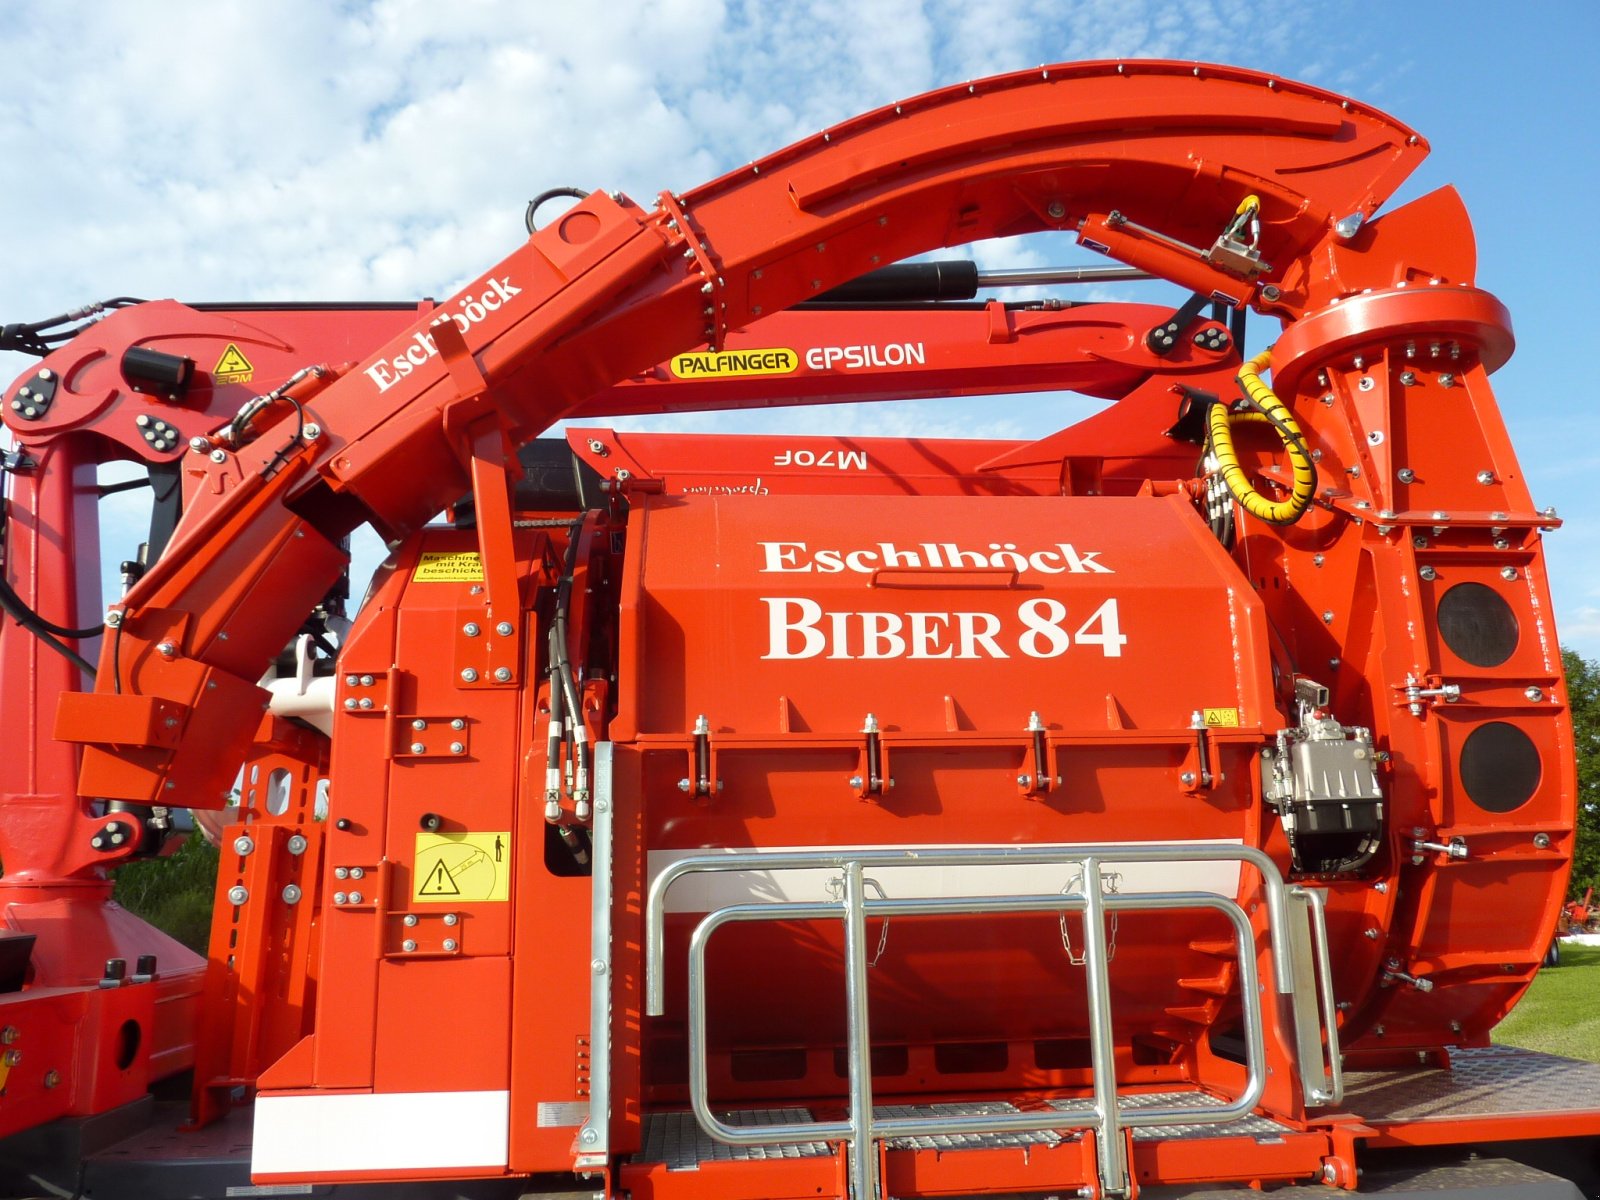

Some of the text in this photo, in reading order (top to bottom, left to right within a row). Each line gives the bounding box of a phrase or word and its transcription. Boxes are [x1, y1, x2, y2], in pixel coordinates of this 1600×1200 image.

[363, 276, 522, 394] Eschböck
[679, 342, 925, 374] PALFINGER EPSILON
[774, 450, 868, 470] M70F
[757, 542, 1116, 573] Eschlböck
[760, 597, 1128, 659] BIBER 84
